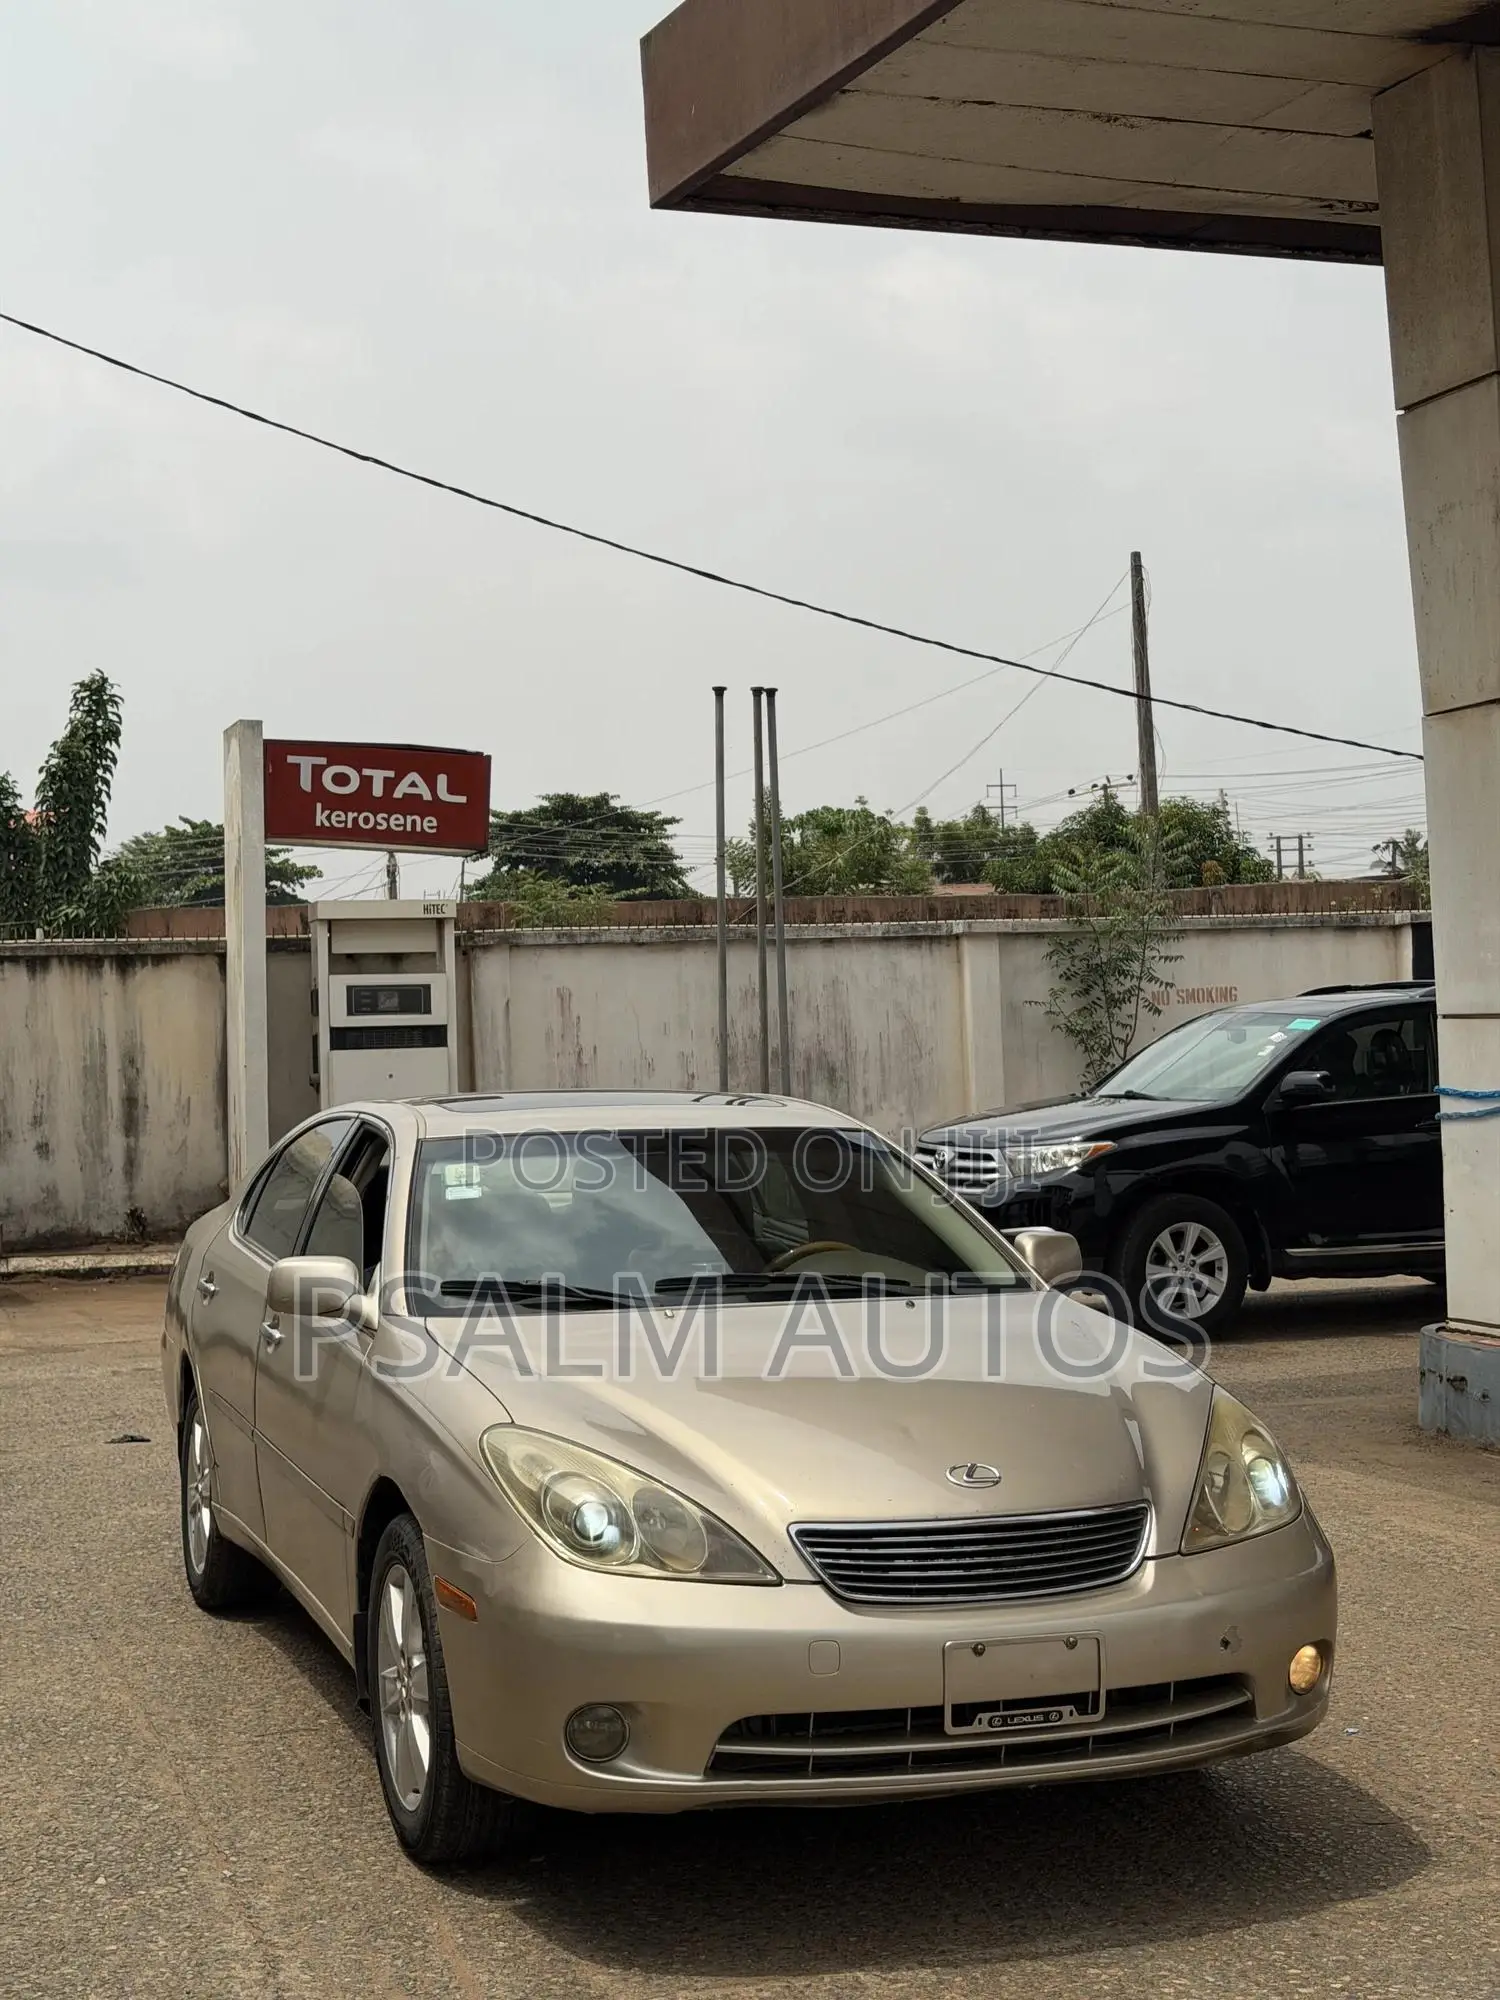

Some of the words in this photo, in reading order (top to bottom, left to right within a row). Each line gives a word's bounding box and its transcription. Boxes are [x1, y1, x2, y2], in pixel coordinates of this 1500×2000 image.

[287, 755, 467, 803] TOTAL
[315, 802, 438, 834] kerosene
[1151, 989, 1170, 1006] NO
[1176, 986, 1238, 1005] SMOKING
[1007, 1714, 1045, 1724] LEXUS
